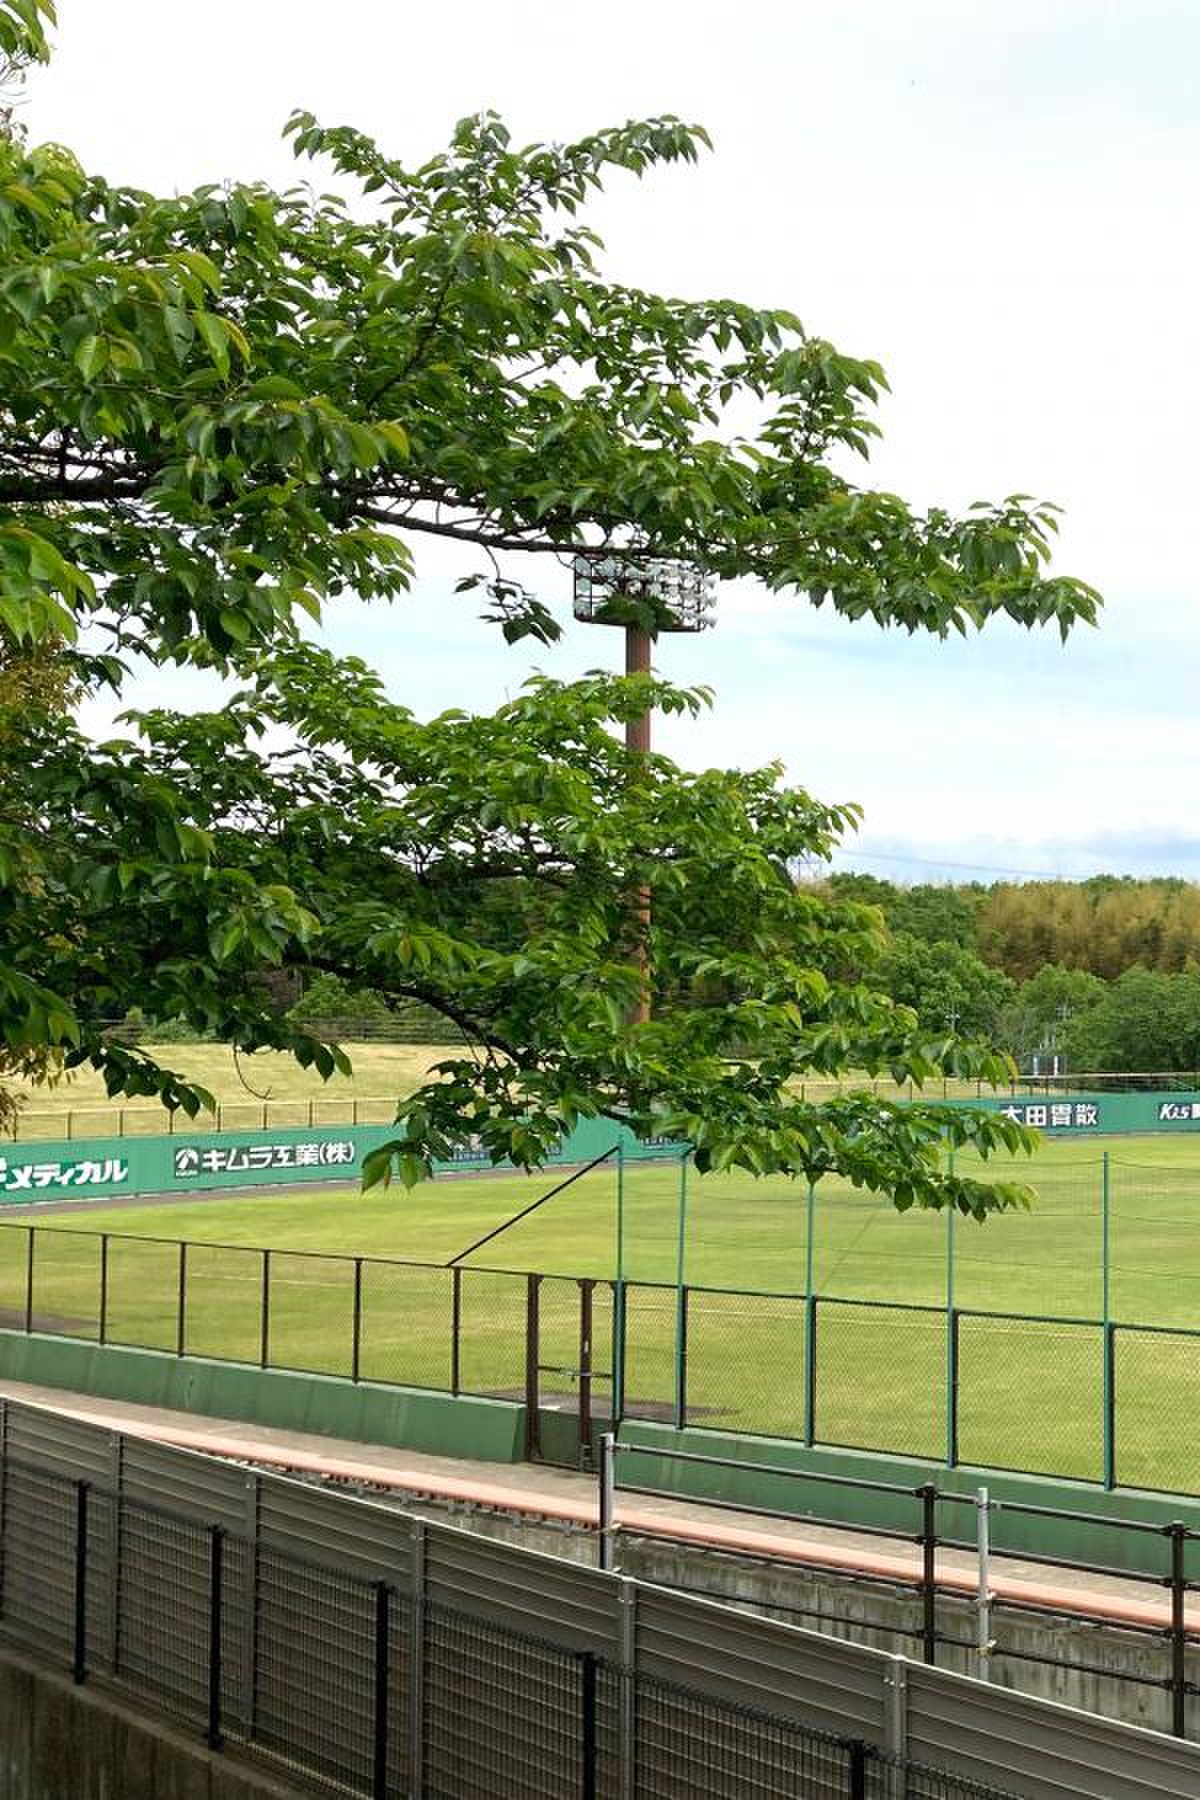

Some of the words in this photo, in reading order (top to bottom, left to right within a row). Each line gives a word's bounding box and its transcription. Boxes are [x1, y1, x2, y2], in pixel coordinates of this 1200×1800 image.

[201, 1142, 356, 1173] キムラ工業(株)
[0, 1157, 129, 1191] メディカル
